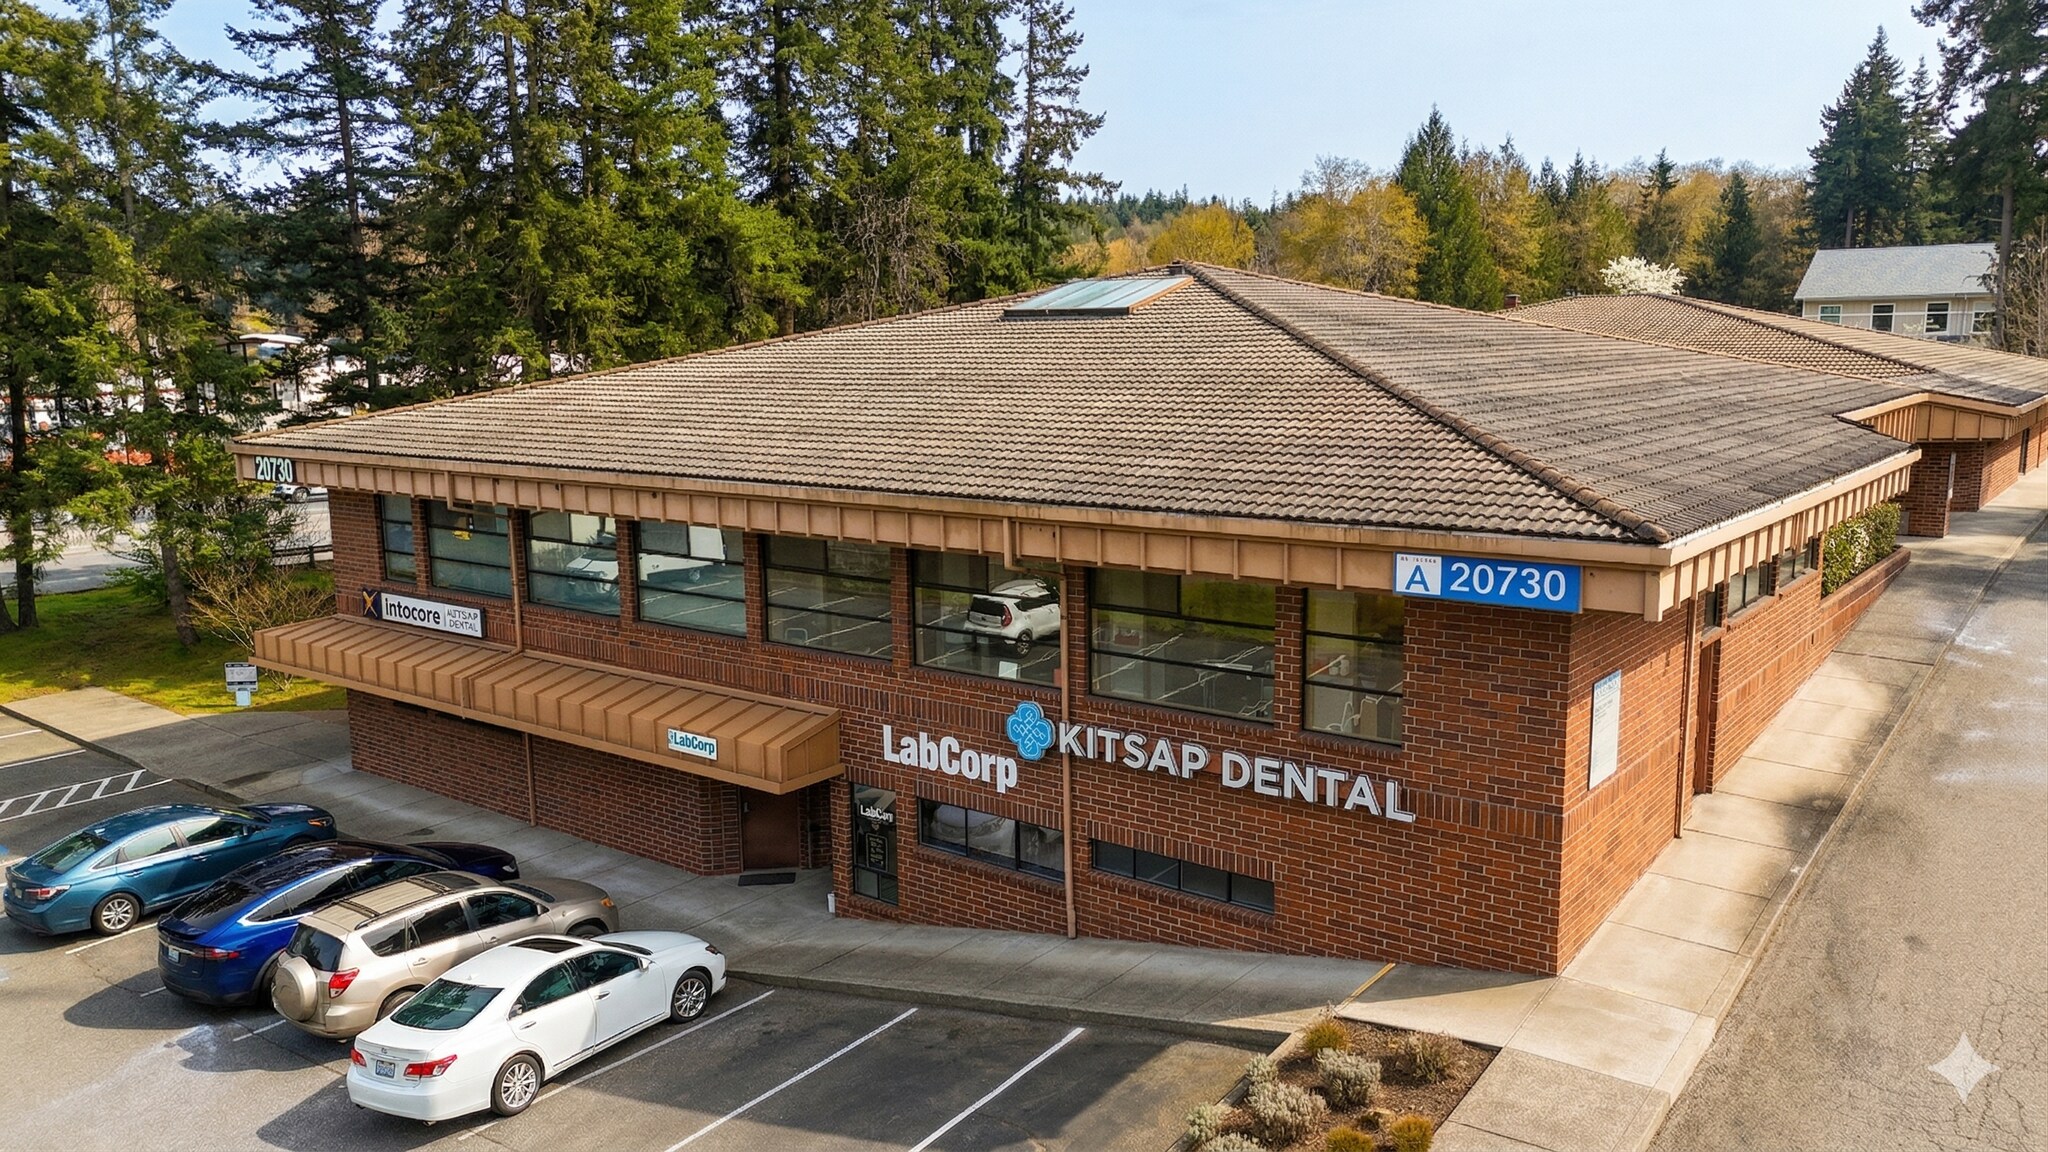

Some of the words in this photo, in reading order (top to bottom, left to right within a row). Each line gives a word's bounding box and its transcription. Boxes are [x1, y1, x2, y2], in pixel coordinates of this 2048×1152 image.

[255, 456, 293, 483] 20730
[1405, 564, 1430, 592] A
[1450, 562, 1566, 602] 20730
[385, 597, 440, 625] intocore
[674, 732, 715, 756] LabCorp
[883, 724, 1018, 794] LabCorp
[1058, 721, 1209, 779] KITSAP
[1221, 749, 1416, 823] DENTAL
